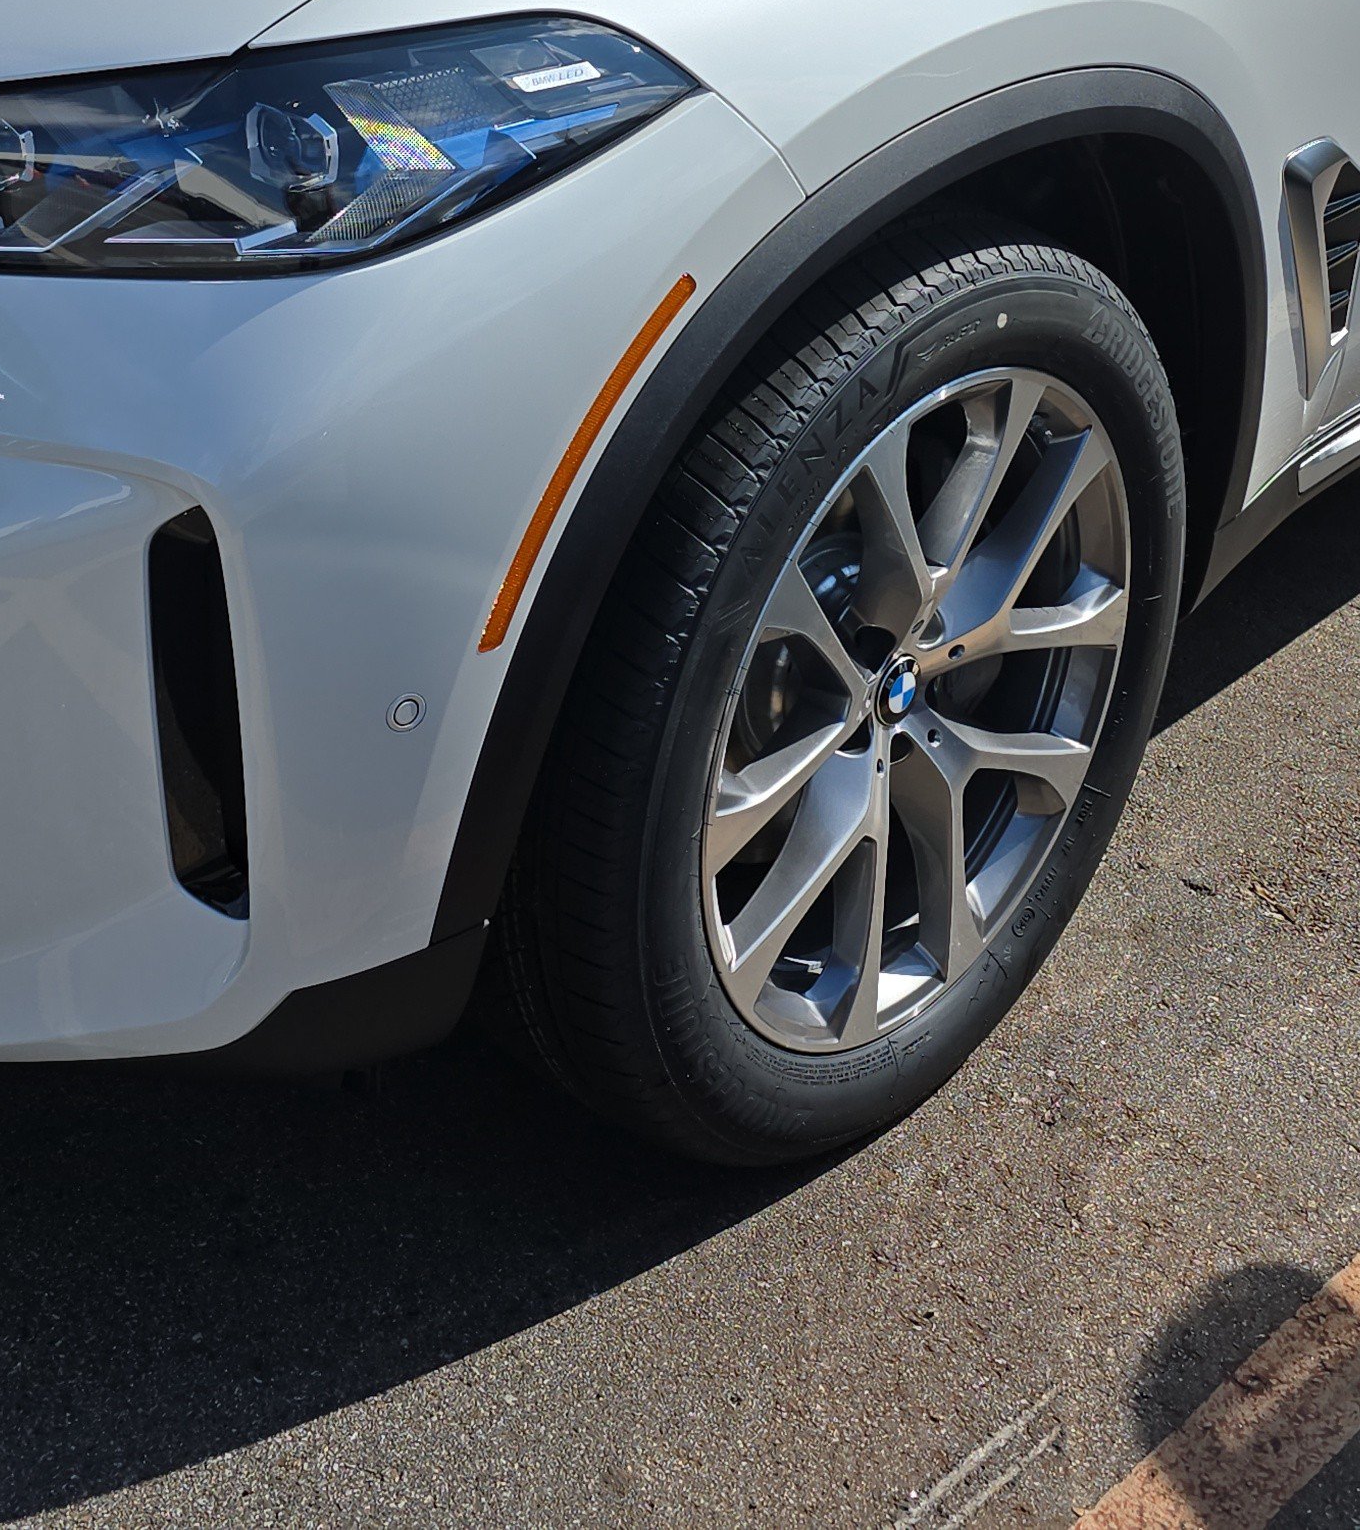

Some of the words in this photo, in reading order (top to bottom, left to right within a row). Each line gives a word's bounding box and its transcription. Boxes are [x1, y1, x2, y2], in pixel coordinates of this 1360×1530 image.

[532, 73, 556, 87] BMW
[558, 68, 584, 81] LED
[1081, 304, 1184, 520] BRIDGESTONE
